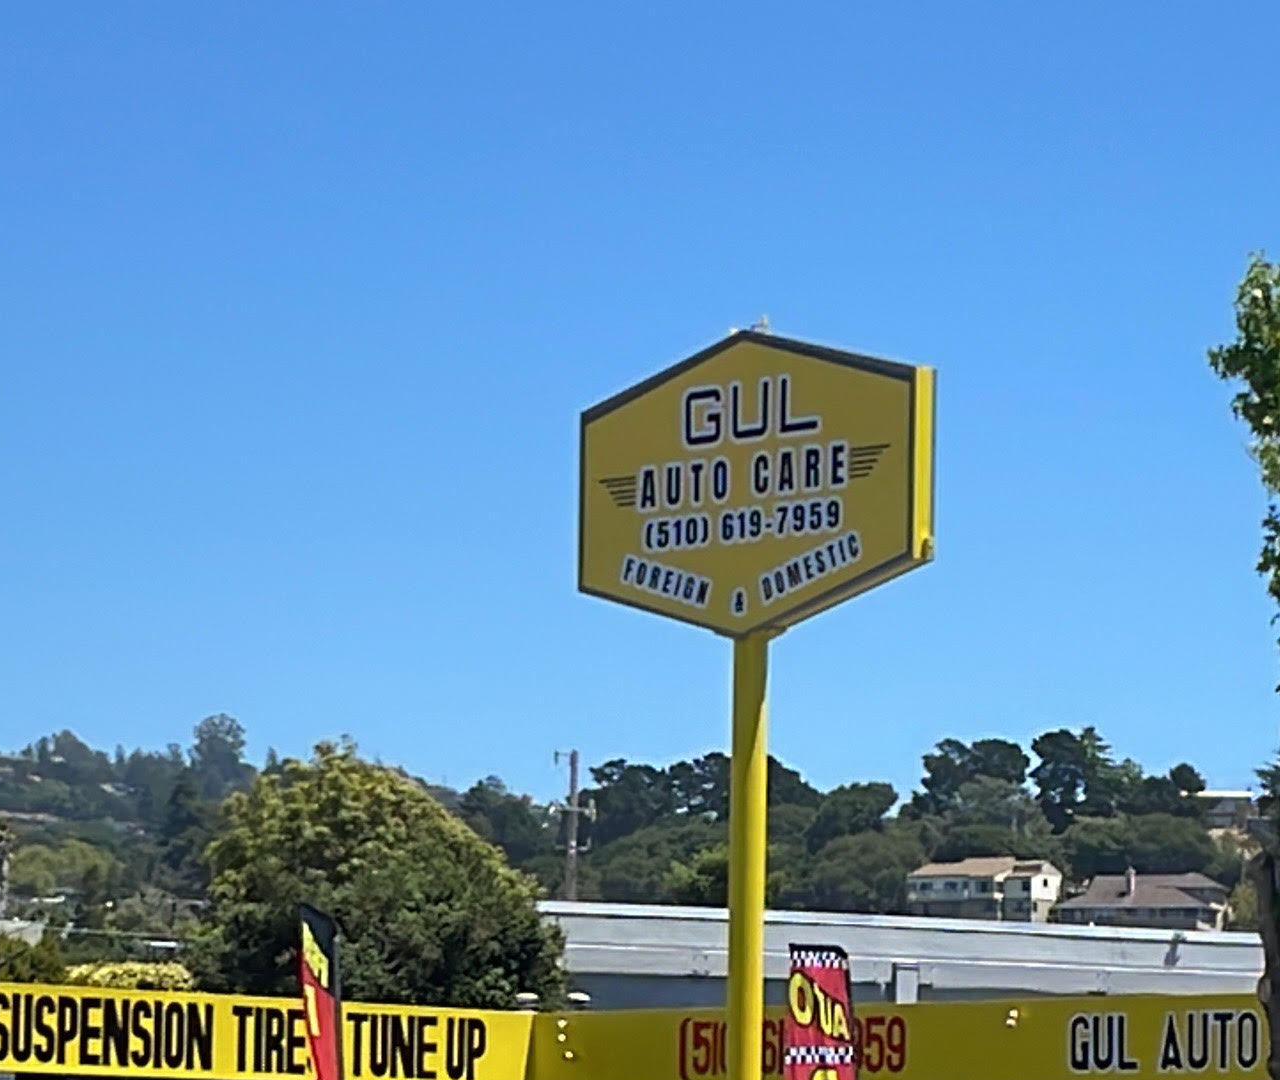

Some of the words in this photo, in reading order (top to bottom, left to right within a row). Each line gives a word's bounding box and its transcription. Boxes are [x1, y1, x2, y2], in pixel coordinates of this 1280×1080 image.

[685, 378, 818, 446] GUL
[640, 460, 728, 509] AUTO
[754, 445, 845, 494] CARE
[645, 516, 709, 549] (510)
[722, 500, 842, 541] 619-7959
[623, 558, 710, 605] FOREIGN
[734, 591, 746, 613] &
[761, 533, 861, 601] DOMESTIC
[232, 1005, 313, 1076] TIRE
[346, 1013, 438, 1080] TUNE
[1071, 1015, 1138, 1070] GUL
[1161, 1012, 1258, 1070] AUTO
